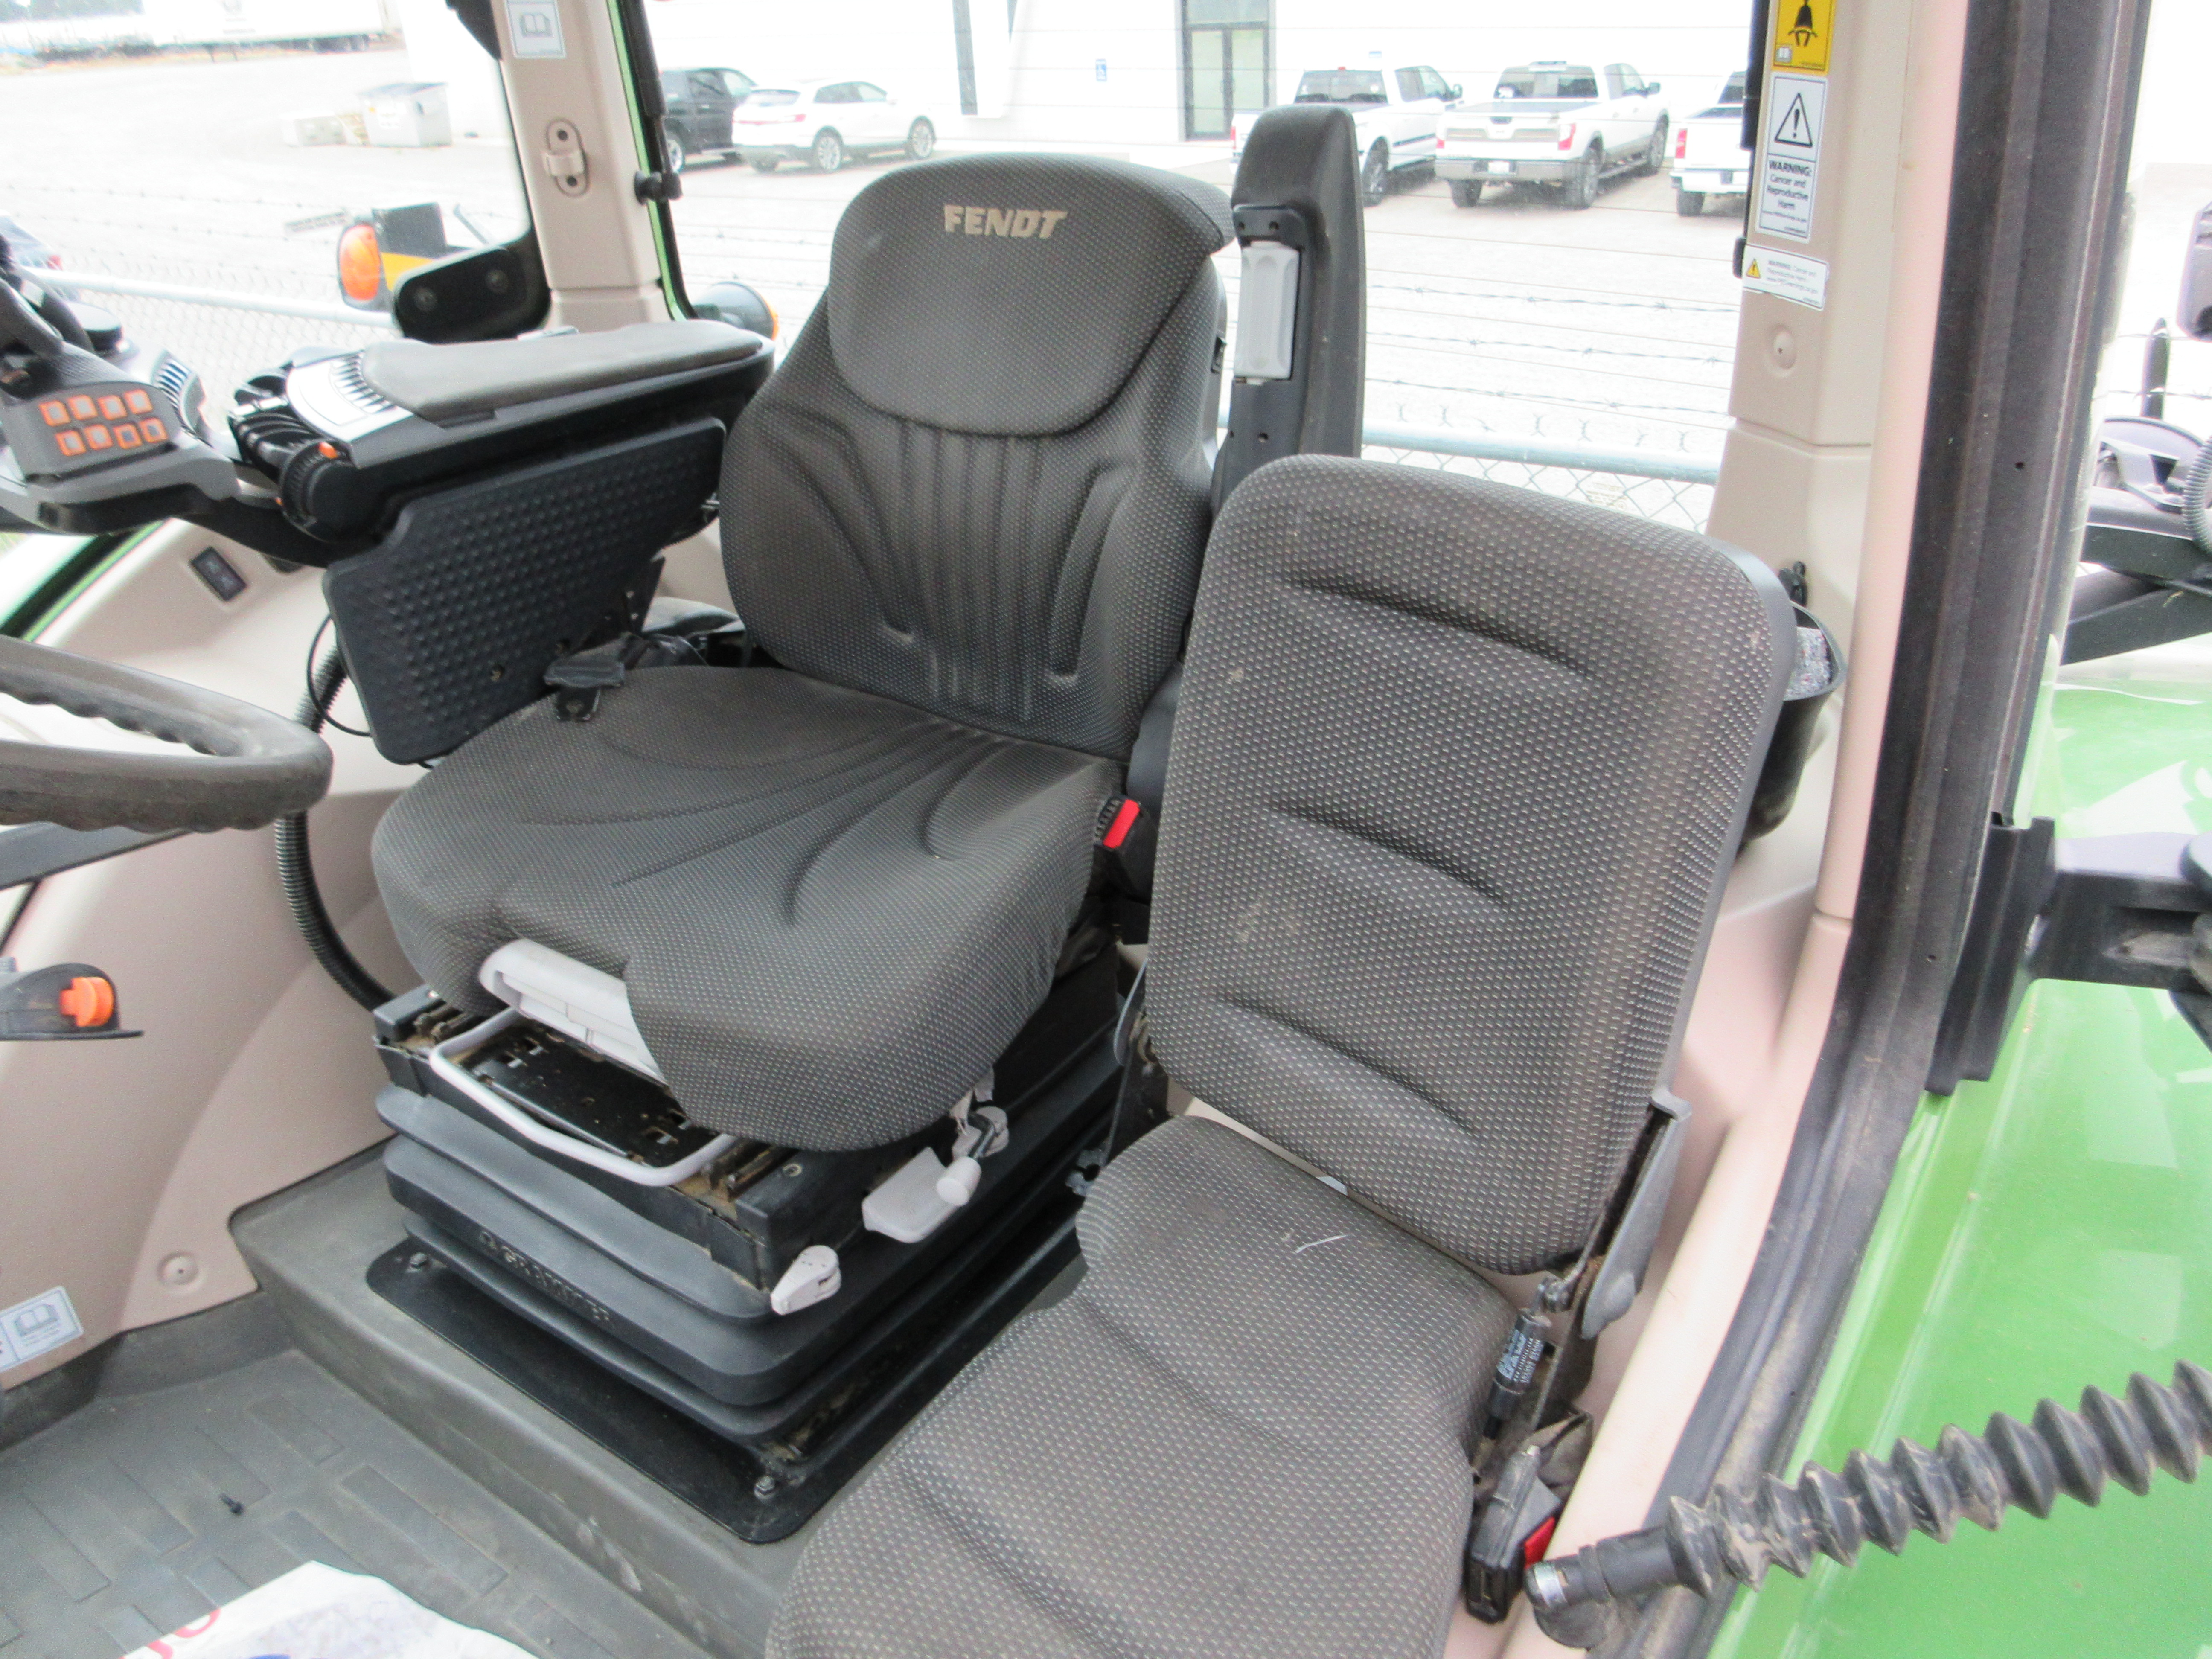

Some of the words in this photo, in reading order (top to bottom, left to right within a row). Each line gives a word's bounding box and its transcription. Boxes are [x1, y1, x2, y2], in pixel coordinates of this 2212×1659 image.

[1769, 160, 1812, 176] WARNING:
[1771, 174, 1792, 185] Cancer
[1794, 179, 1806, 188] and
[1767, 185, 1808, 201] Reproductive
[1778, 199, 1795, 209] Harm
[944, 204, 1068, 239] FENDT
